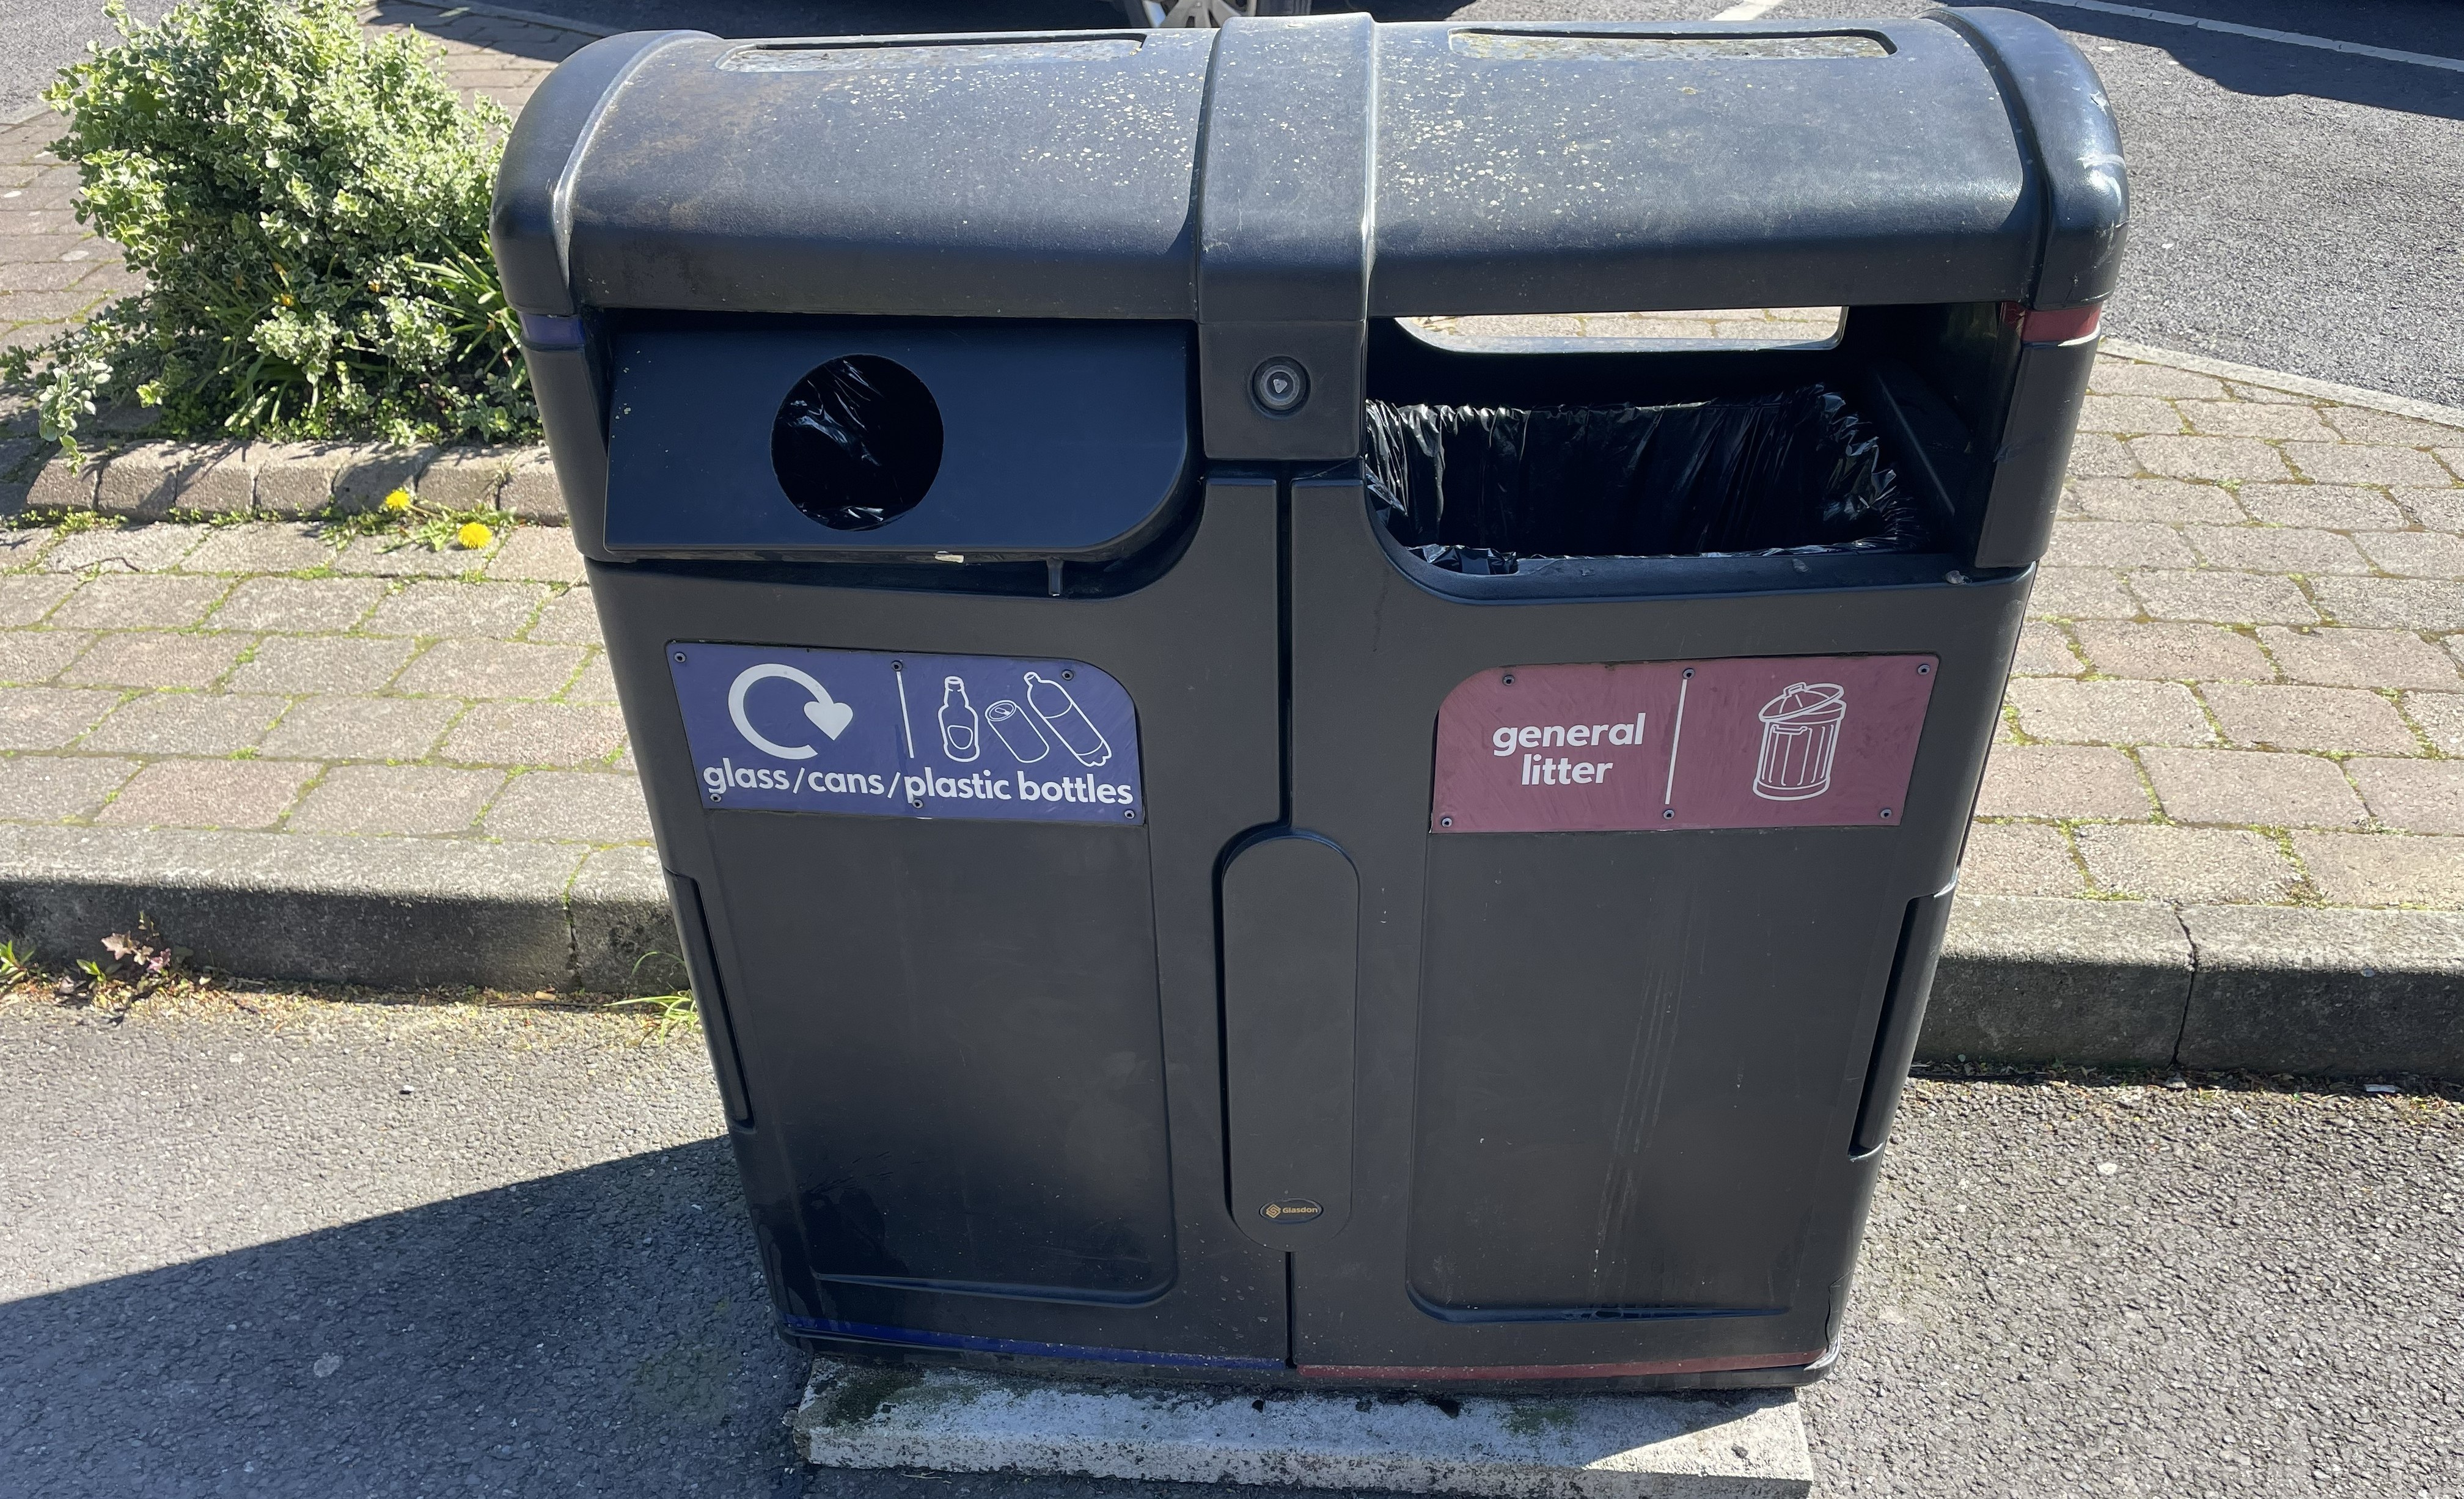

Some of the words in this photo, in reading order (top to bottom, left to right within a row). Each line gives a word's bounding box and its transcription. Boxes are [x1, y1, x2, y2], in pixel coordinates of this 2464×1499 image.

[1492, 713, 1646, 757] general
[1522, 753, 1614, 786] litter
[1017, 770, 1134, 805] bottles
